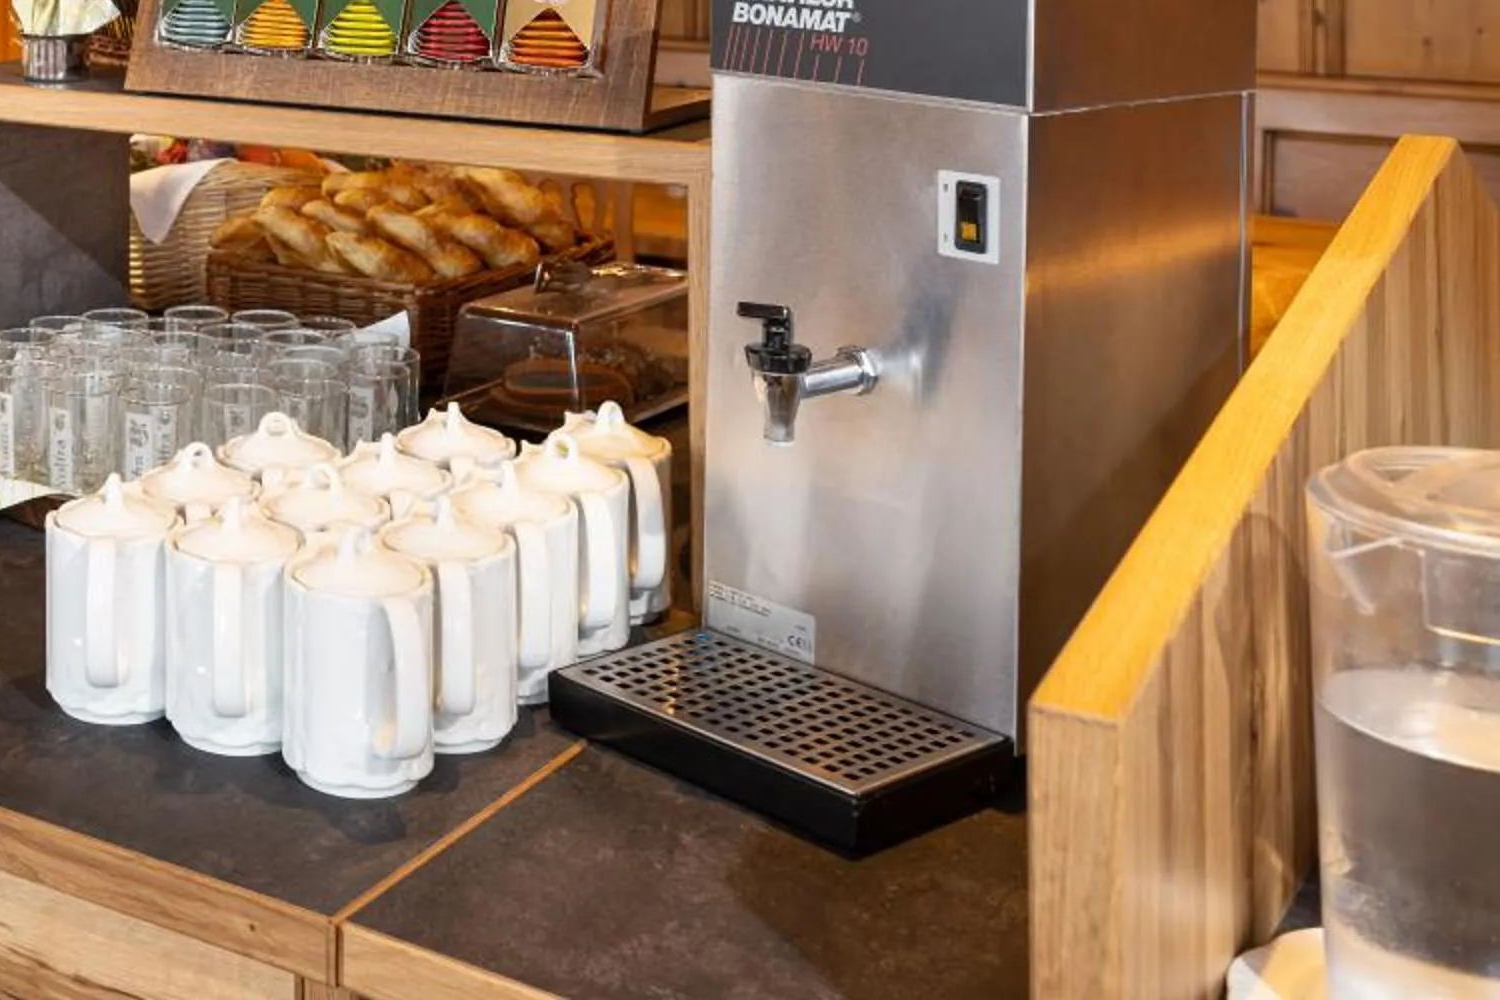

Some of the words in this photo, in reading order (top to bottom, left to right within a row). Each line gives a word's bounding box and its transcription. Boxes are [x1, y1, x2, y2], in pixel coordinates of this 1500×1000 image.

[732, 2, 852, 33] BONAMAT
[810, 33, 842, 53] HW
[848, 37, 869, 57] 10
